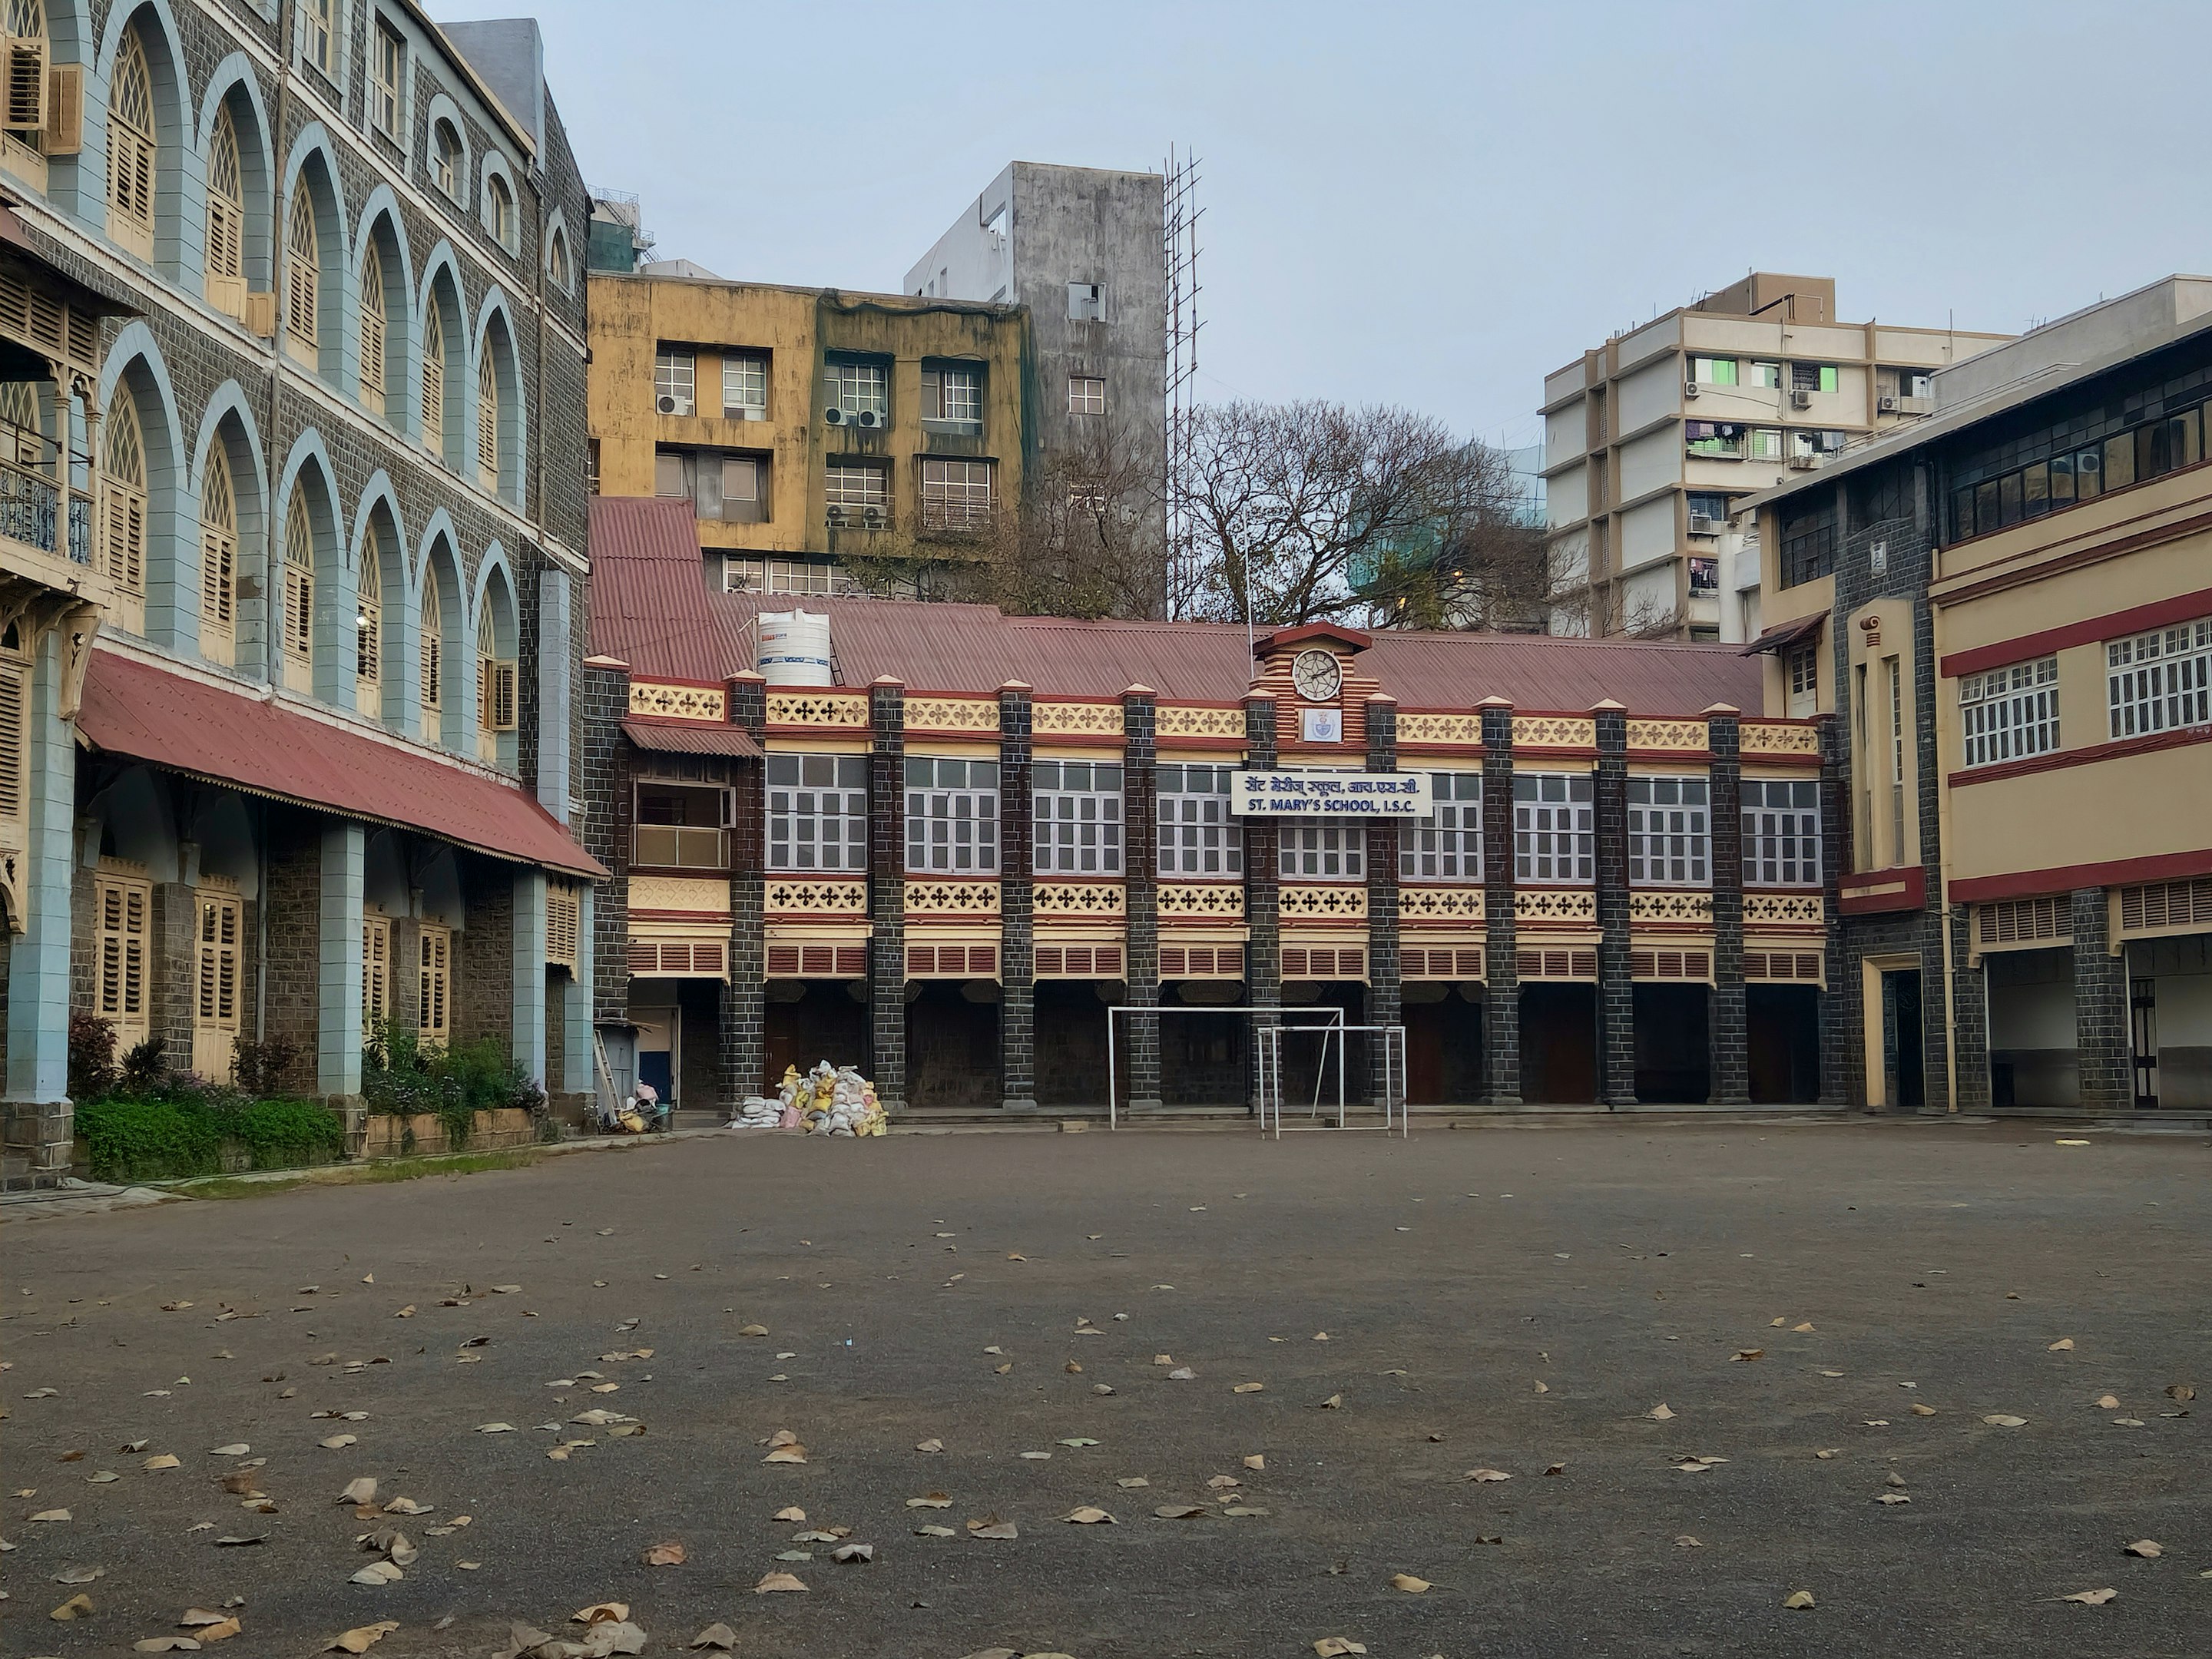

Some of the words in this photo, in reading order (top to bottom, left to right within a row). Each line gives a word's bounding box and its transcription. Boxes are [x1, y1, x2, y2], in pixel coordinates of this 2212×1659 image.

[1245, 776, 1266, 791] सेंट
[1248, 799, 1267, 811] ST.
[1270, 800, 1321, 811] MARY'S
[1323, 800, 1380, 814] SCHOOL,
[1384, 800, 1416, 812] I.S.C.
